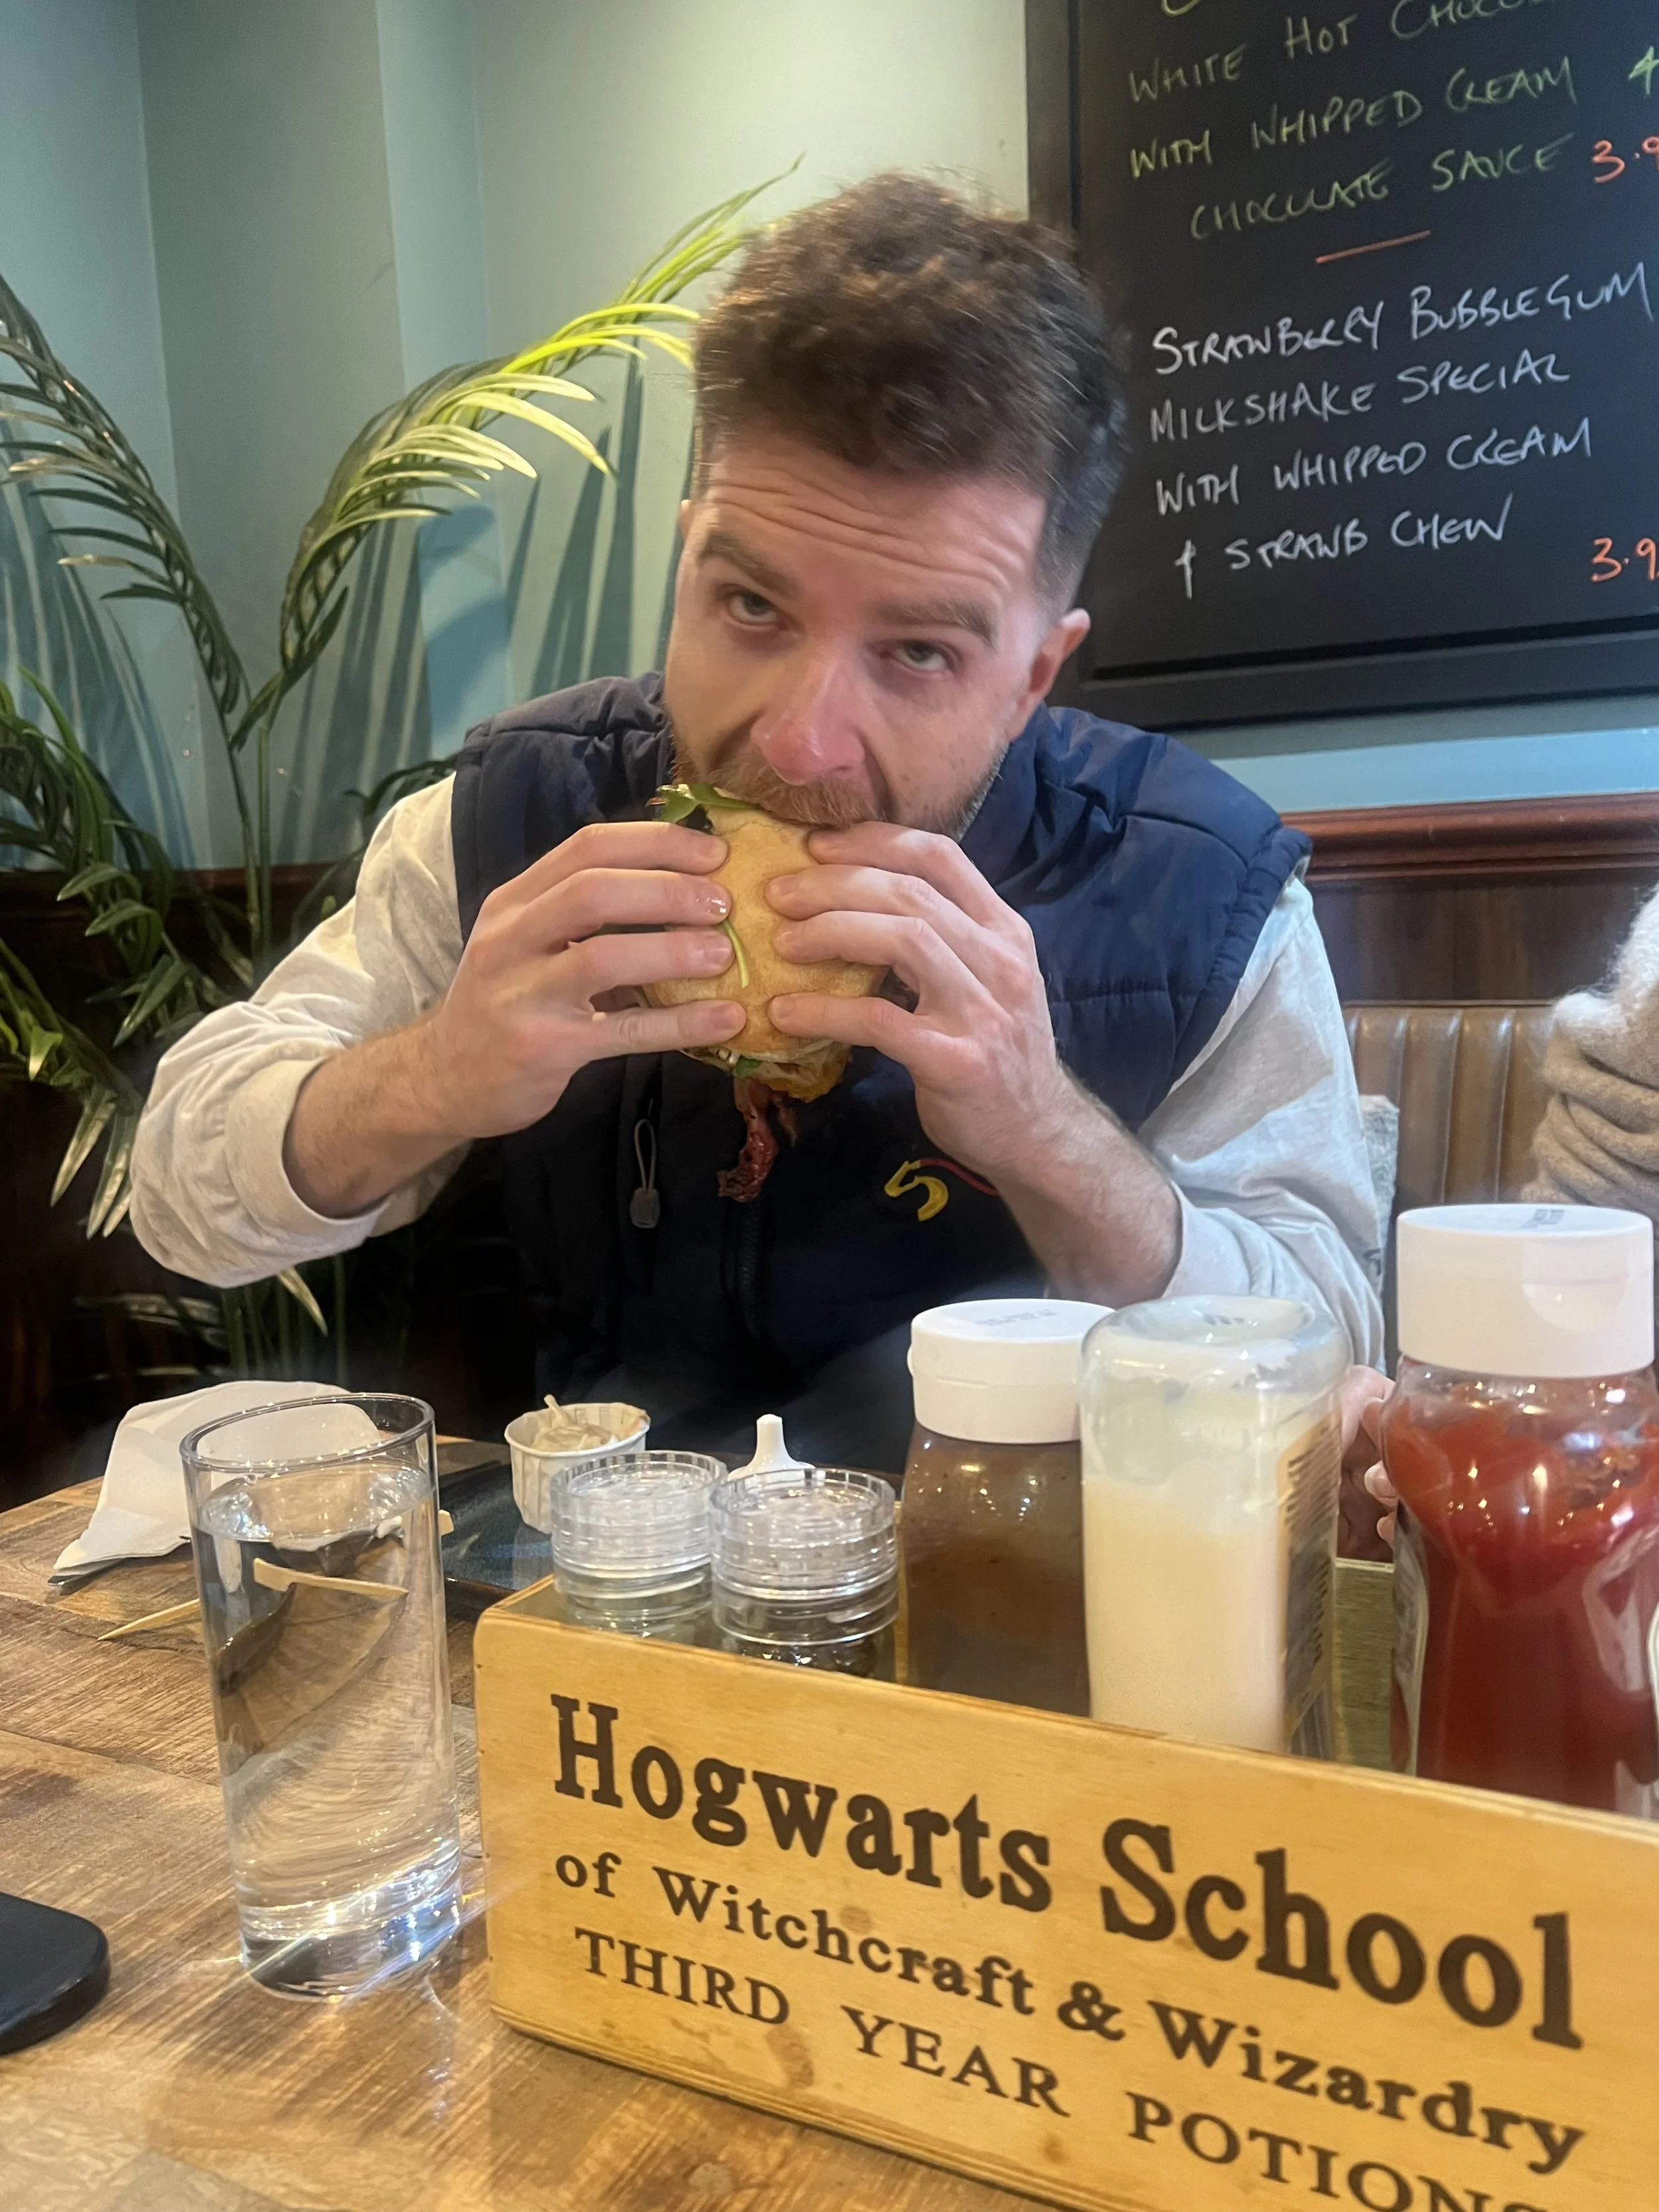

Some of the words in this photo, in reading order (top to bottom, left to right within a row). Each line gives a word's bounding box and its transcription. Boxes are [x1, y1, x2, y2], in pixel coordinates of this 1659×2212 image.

[1129, 43, 1246, 102] WHITE
[1285, 14, 1358, 59] HOT
[1130, 129, 1213, 179] WITH
[1251, 90, 1423, 151] WHIPPED
[1445, 56, 1577, 113] CREAM
[1431, 133, 1575, 192] SAUCE
[1150, 383, 1376, 442] MILKSHAKE
[1398, 349, 1570, 404] SPECIAL
[1157, 465, 1240, 515] WITH
[1274, 442, 1425, 490] WHIPPED
[1447, 417, 1591, 471] CREAM
[1224, 518, 1368, 570] STRAWB
[1391, 492, 1514, 550] CHEW
[550, 1693, 1052, 1913] Hogwarts
[1100, 1817, 1583, 2049] School
[555, 1852, 622, 1897] of
[653, 1866, 1035, 2015] Witchcraft
[1057, 1981, 1126, 2041] &
[1147, 2000, 1587, 2174] Wizardry
[575, 1927, 790, 2026] THIRD
[839, 2005, 1070, 2116] YEAR
[1124, 2090, 1549, 2212] POTION
